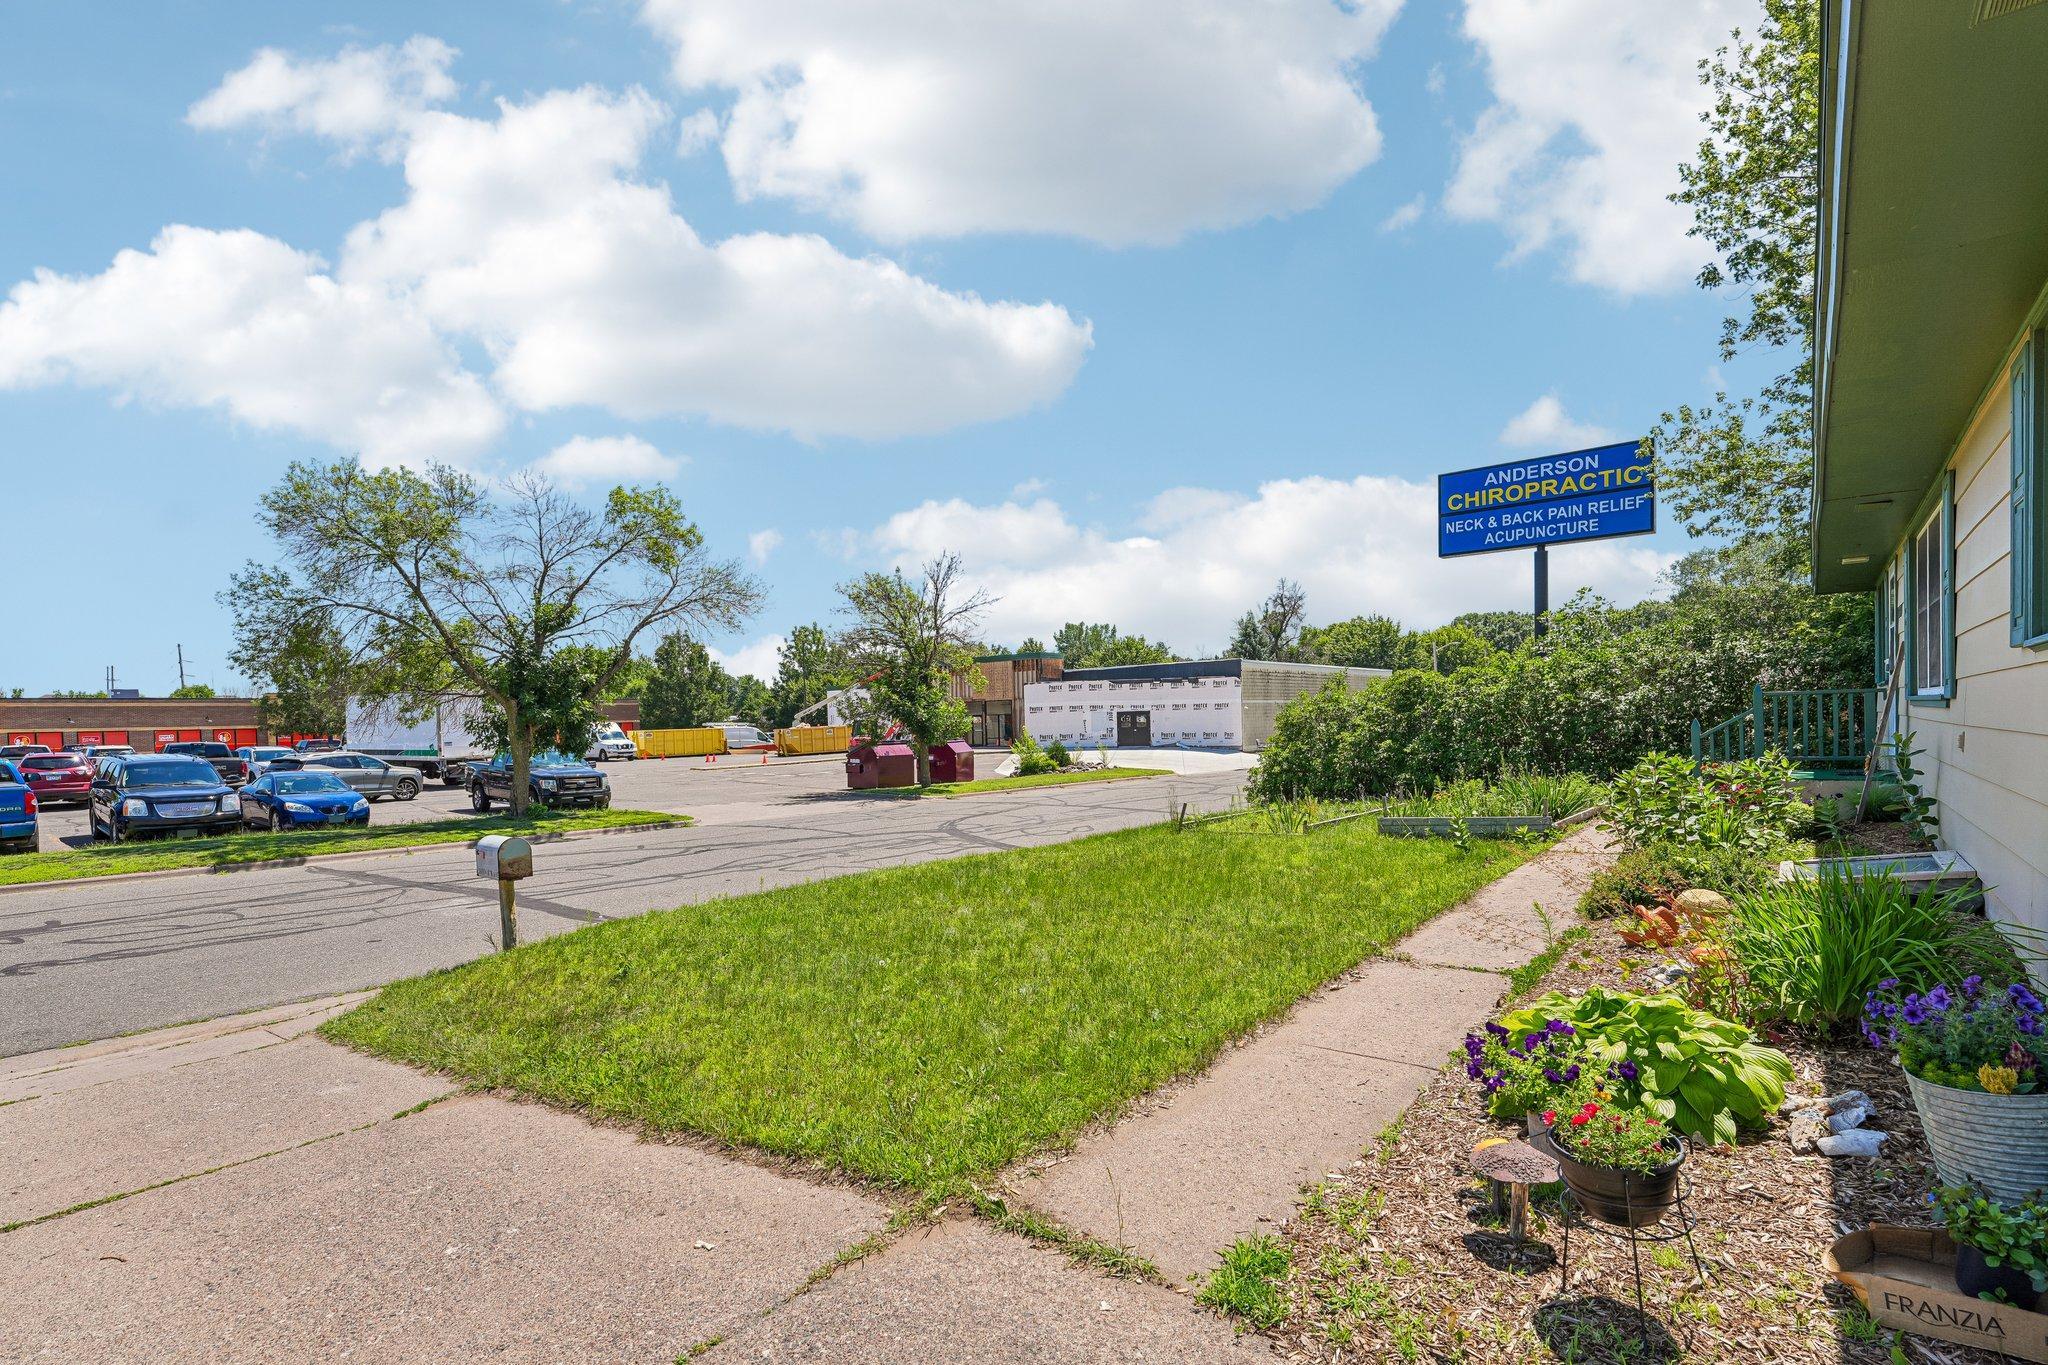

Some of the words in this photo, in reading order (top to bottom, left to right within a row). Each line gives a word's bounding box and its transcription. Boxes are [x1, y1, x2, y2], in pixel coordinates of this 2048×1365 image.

[1447, 465, 1644, 511] CHIROPRACTIC
[1484, 454, 1599, 487] ANDERSON
[1446, 517, 1484, 534] NECK
[1488, 516, 1498, 529] &
[1502, 509, 1543, 527] BACK
[1548, 504, 1583, 520] PAIN
[1588, 495, 1646, 514] RELIEF
[1484, 518, 1599, 545] ACUPUNCTURE
[1884, 1291, 2006, 1335] FRANZIA
